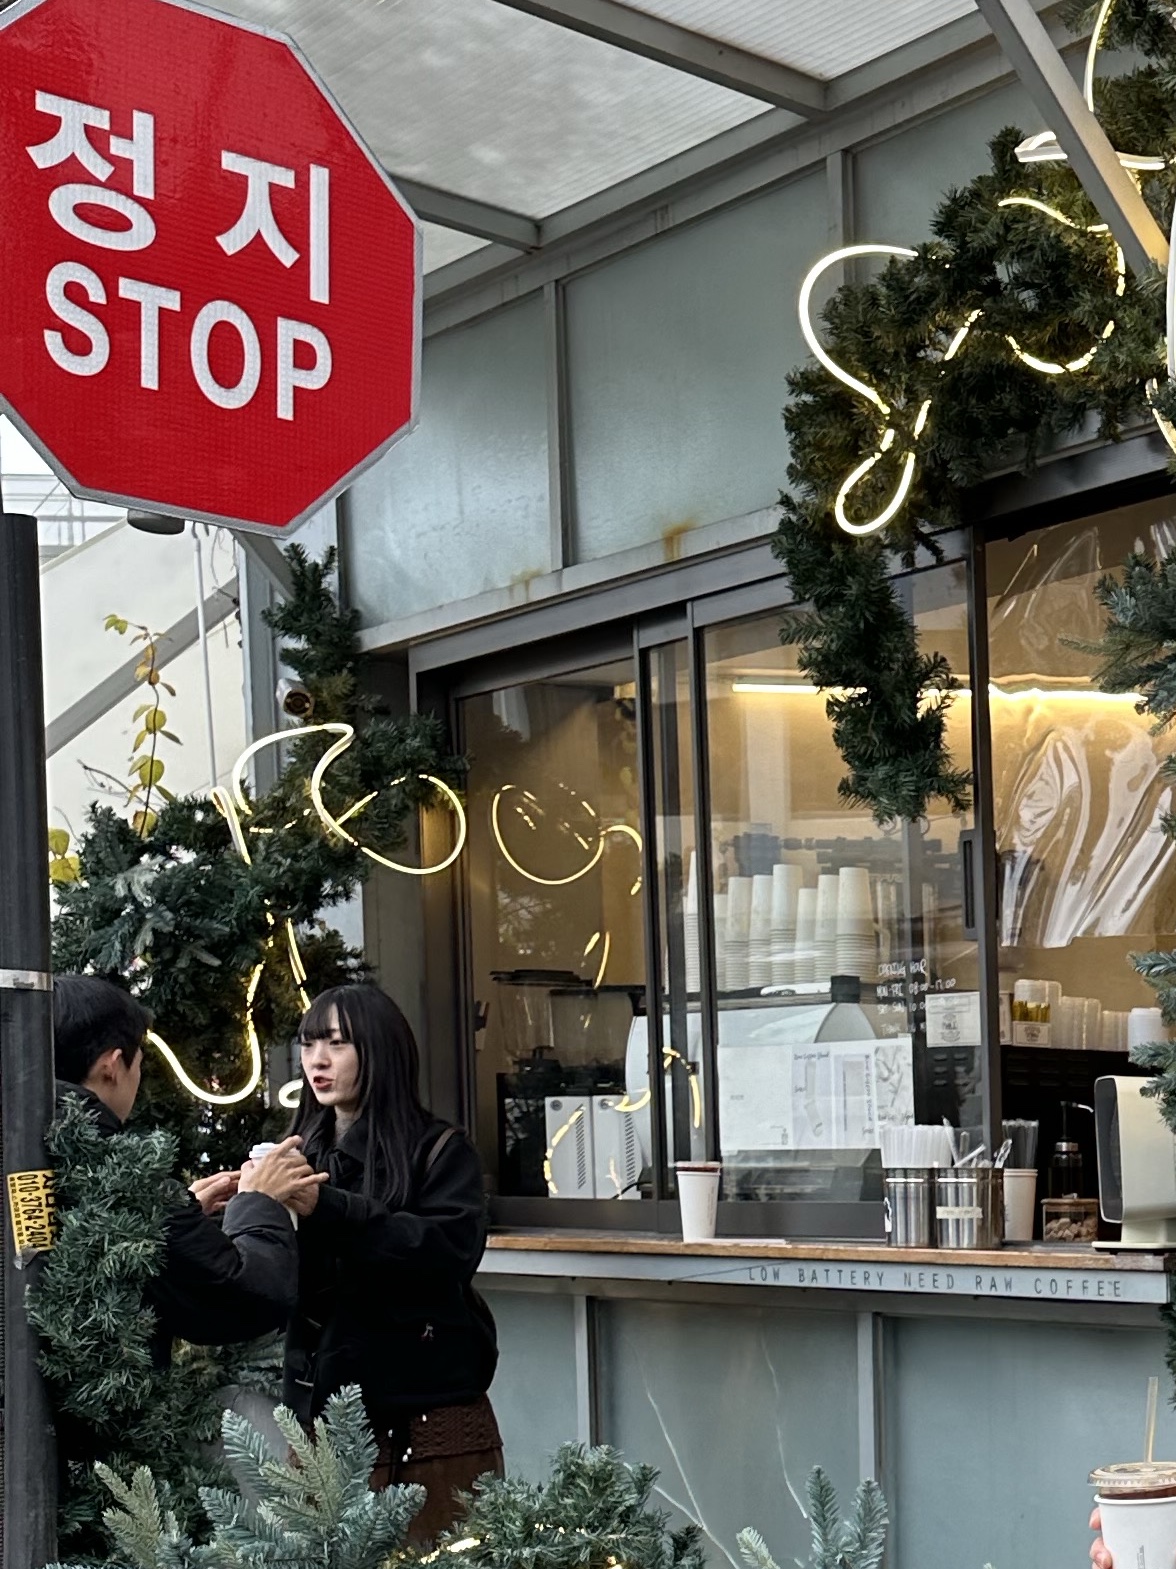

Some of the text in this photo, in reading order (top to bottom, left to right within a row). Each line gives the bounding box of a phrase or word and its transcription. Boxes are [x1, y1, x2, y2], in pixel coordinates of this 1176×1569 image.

[44, 262, 332, 420] STOP
[748, 1265, 1121, 1298] LOW BATTERY NEED RAW COFFEE
